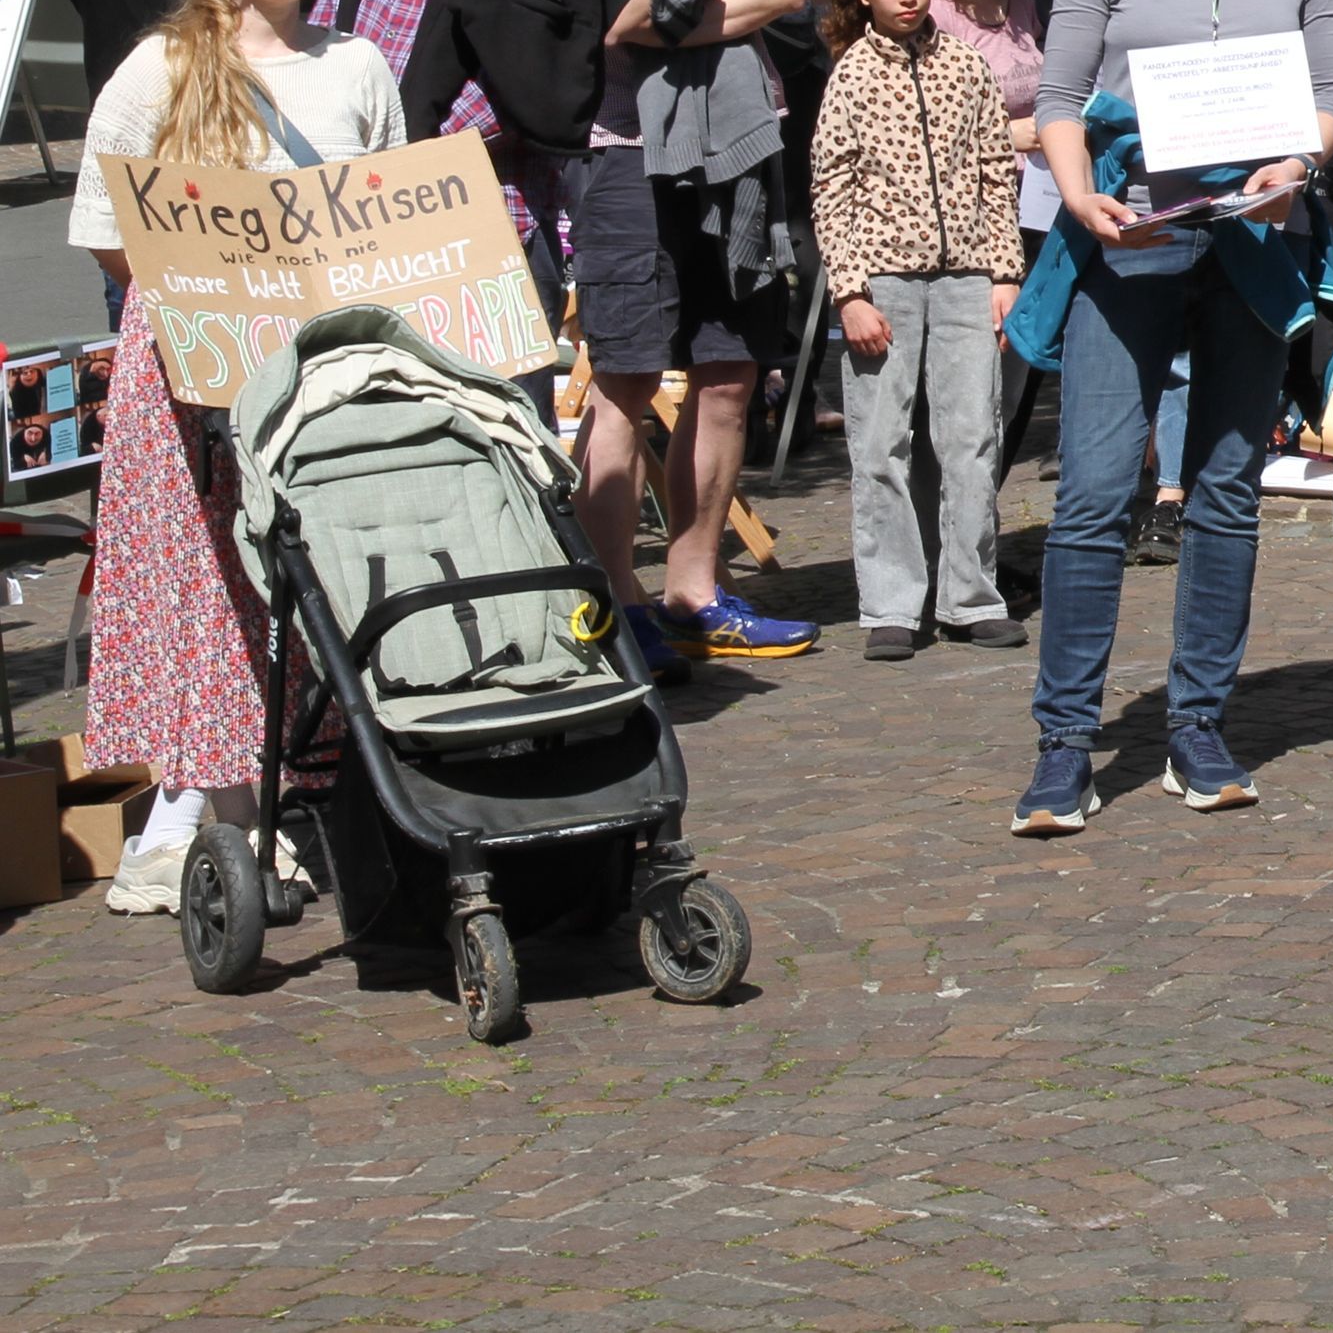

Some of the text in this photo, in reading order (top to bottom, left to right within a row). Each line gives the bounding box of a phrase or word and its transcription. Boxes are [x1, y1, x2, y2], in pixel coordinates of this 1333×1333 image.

[125, 162, 471, 254] Krieg & Krisen
[242, 268, 305, 301] Welt
[328, 238, 472, 300] BRAUCHT
[275, 246, 329, 267] noch
[345, 239, 379, 259] nie
